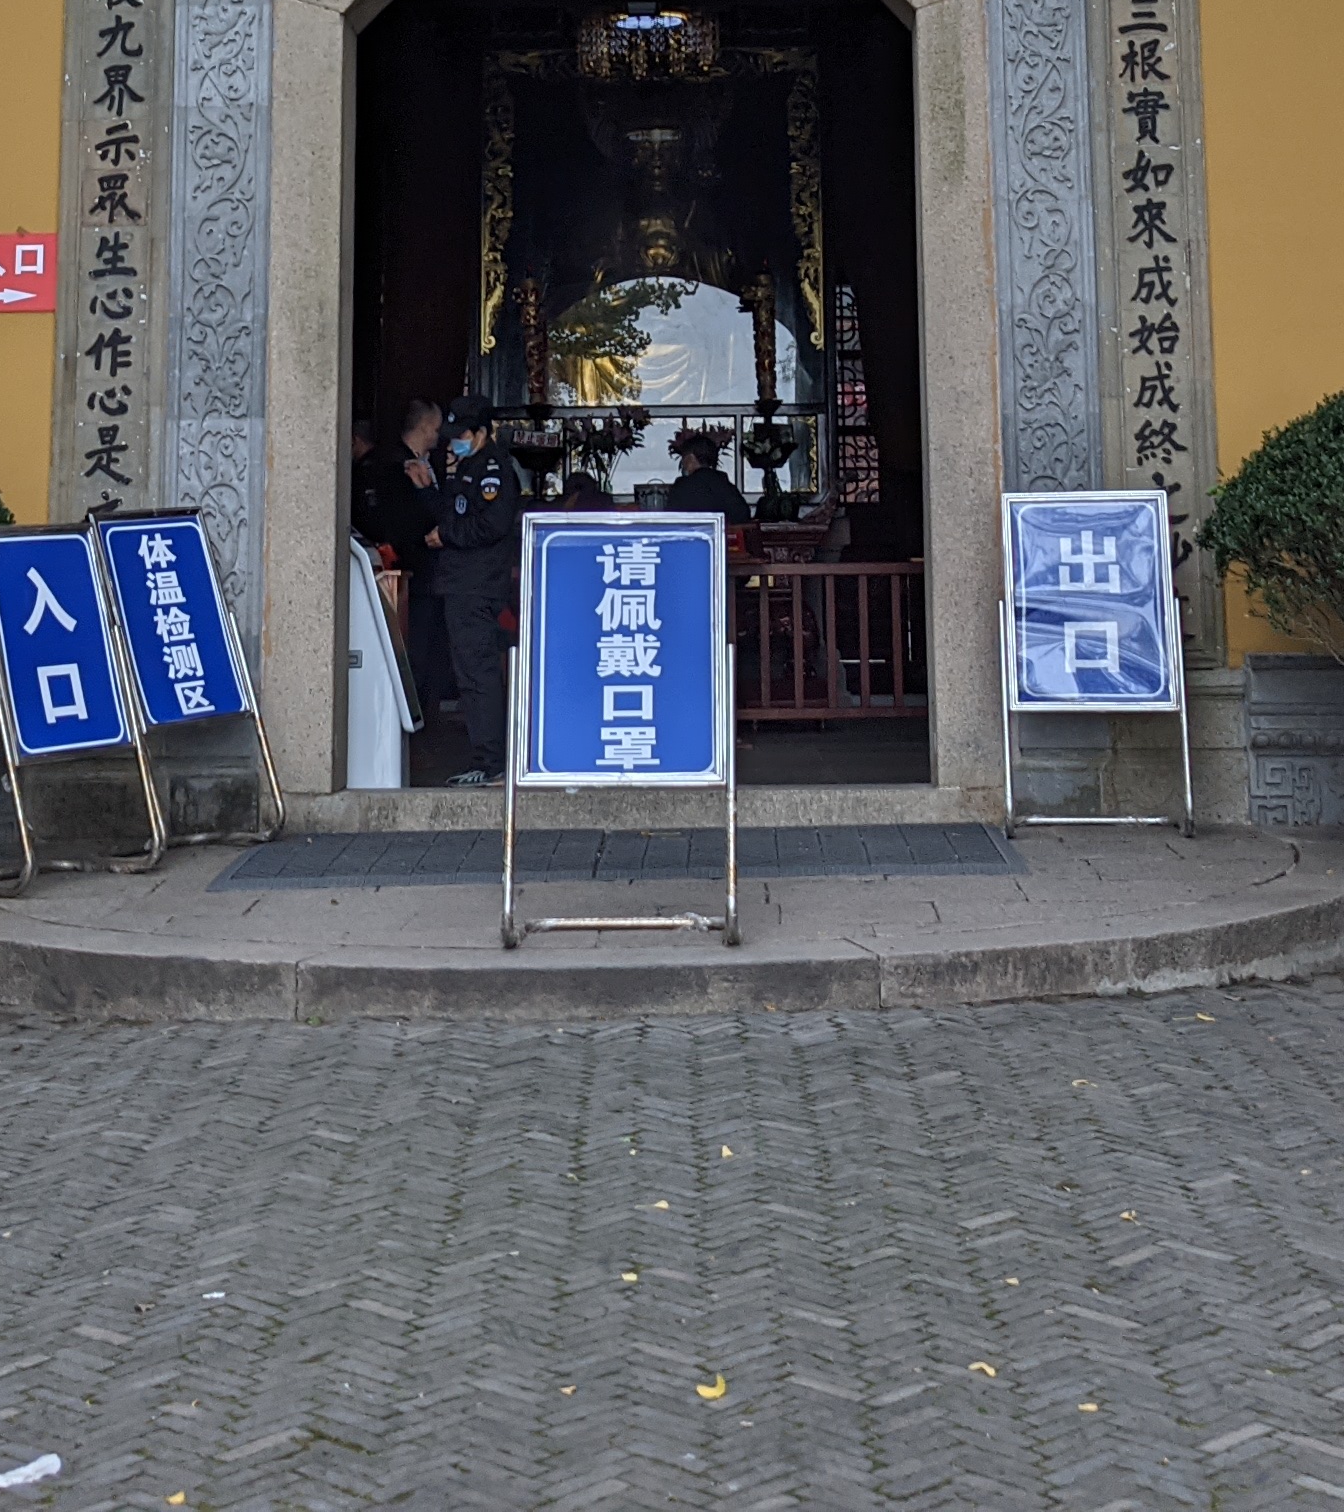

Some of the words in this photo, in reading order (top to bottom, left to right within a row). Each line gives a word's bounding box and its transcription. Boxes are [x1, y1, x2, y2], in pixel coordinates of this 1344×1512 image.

[23, 566, 89, 725] 入口
[137, 532, 216, 716] 体温检测区
[594, 541, 663, 771] 请佩戴口罩
[1058, 530, 1121, 674] 出口
